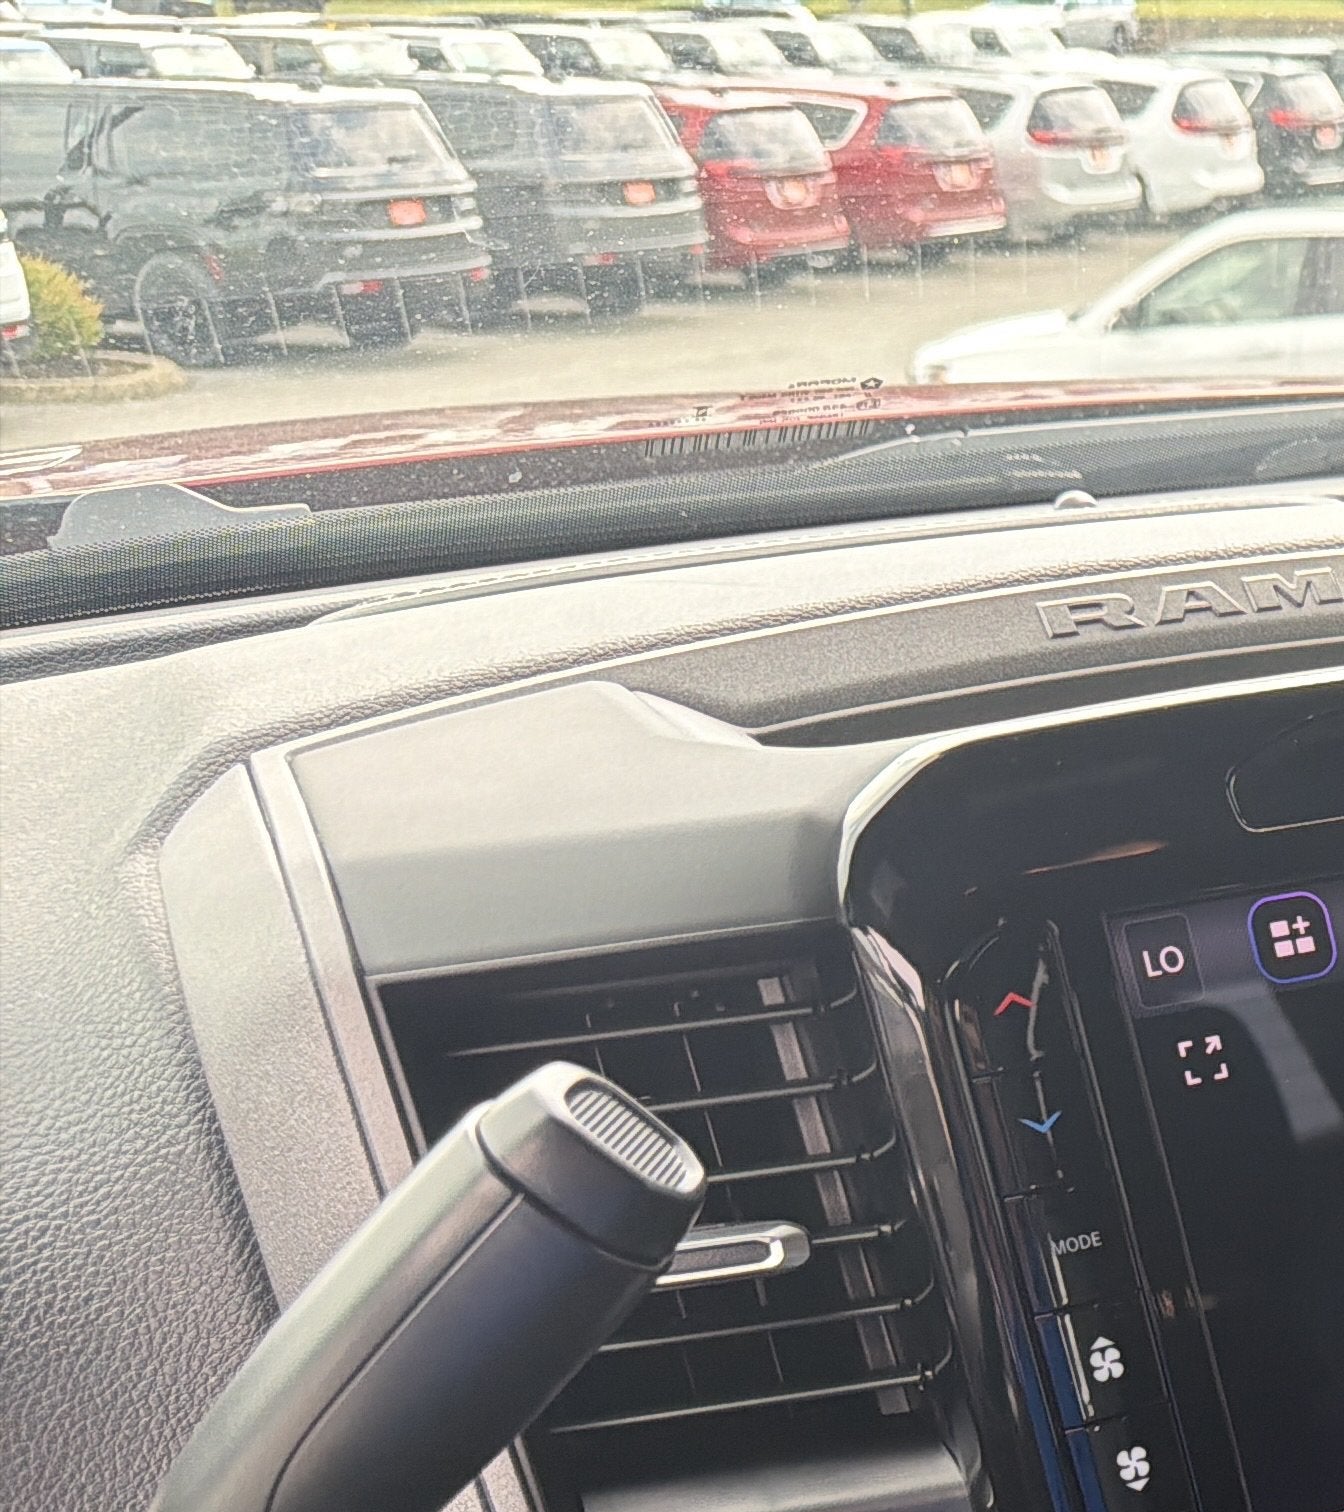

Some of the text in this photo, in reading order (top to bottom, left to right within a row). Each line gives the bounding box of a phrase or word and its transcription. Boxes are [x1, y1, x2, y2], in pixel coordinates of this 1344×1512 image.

[1034, 566, 1344, 639] RAM
[1143, 945, 1185, 979] LO
[1050, 1231, 1102, 1256] MODE
